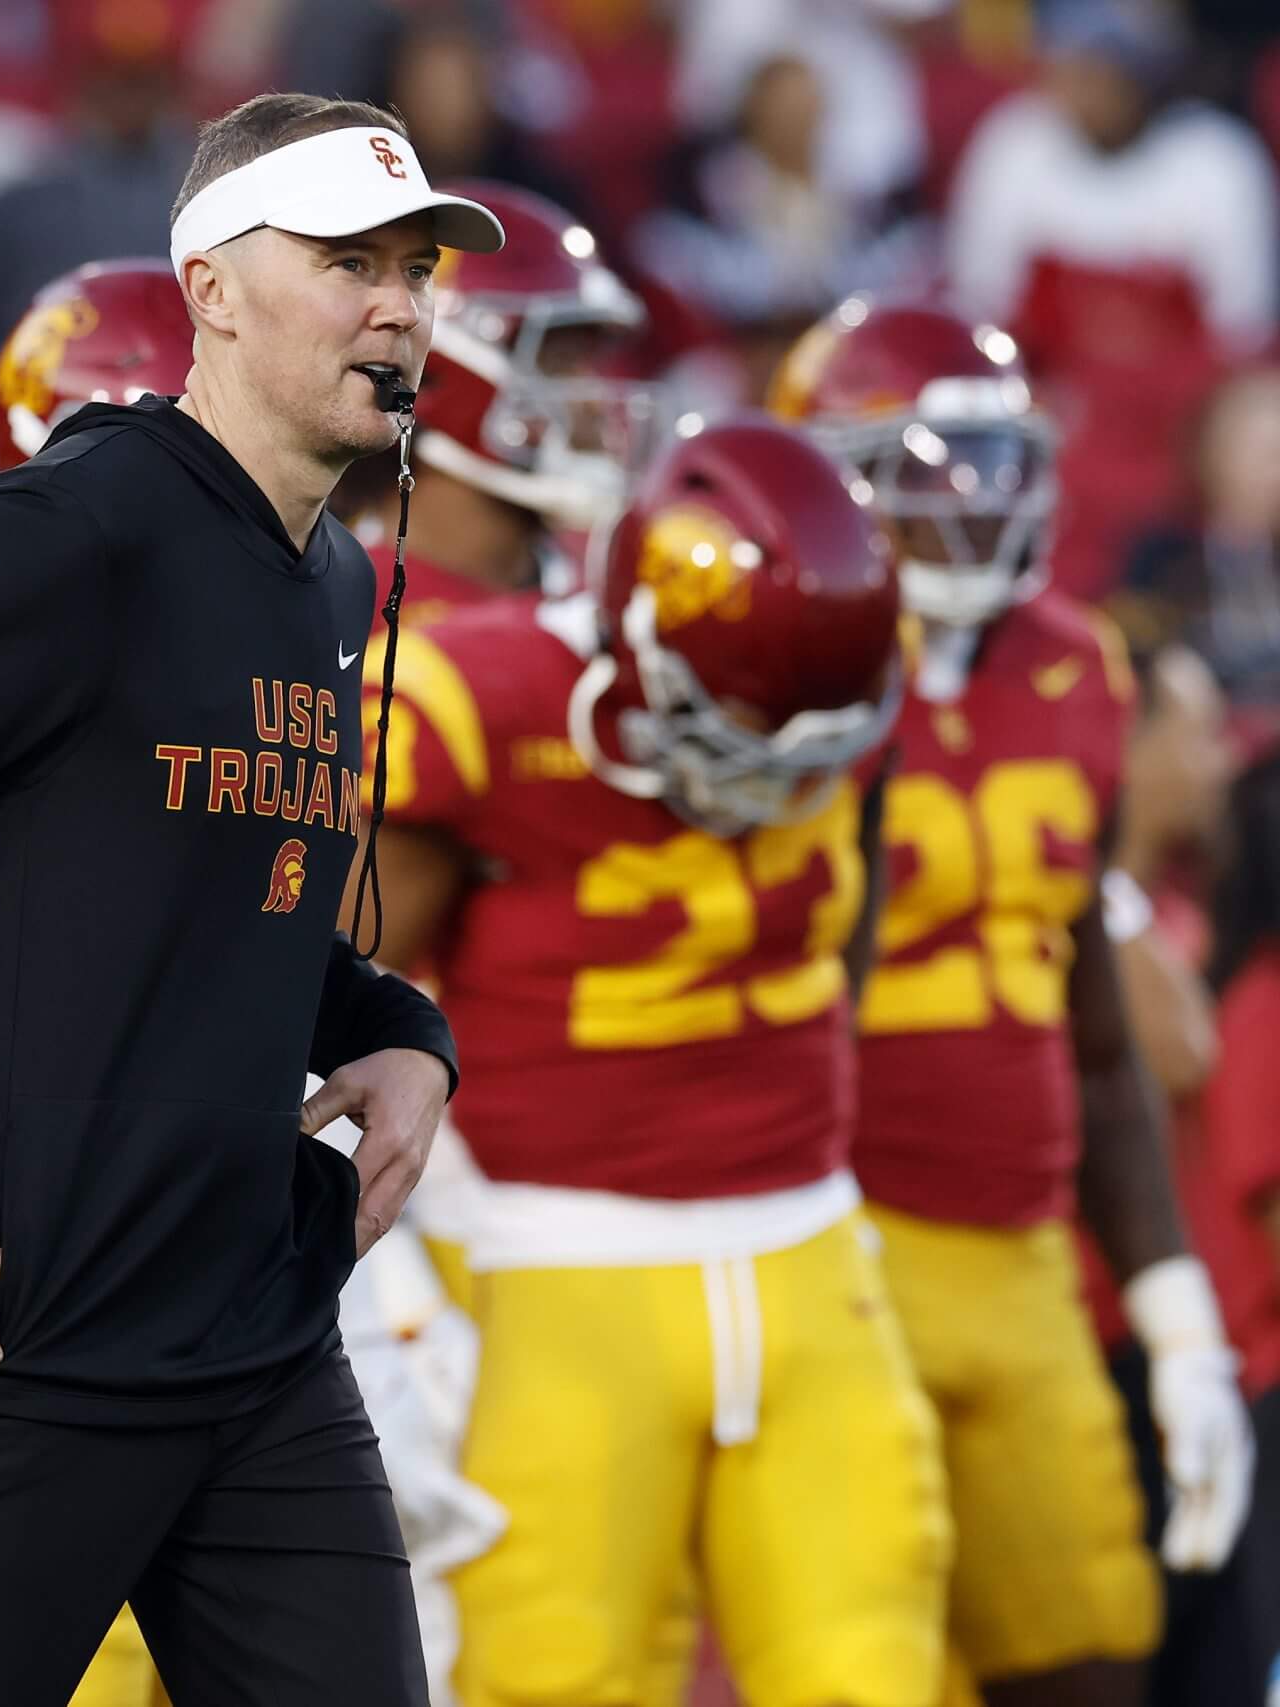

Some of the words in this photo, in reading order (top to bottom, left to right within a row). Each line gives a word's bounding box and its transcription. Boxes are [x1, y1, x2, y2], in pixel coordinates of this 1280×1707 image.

[155, 743, 362, 837] TROJAN
[252, 677, 338, 756] USC
[568, 777, 866, 1049] 23
[857, 759, 1097, 1030] 26
